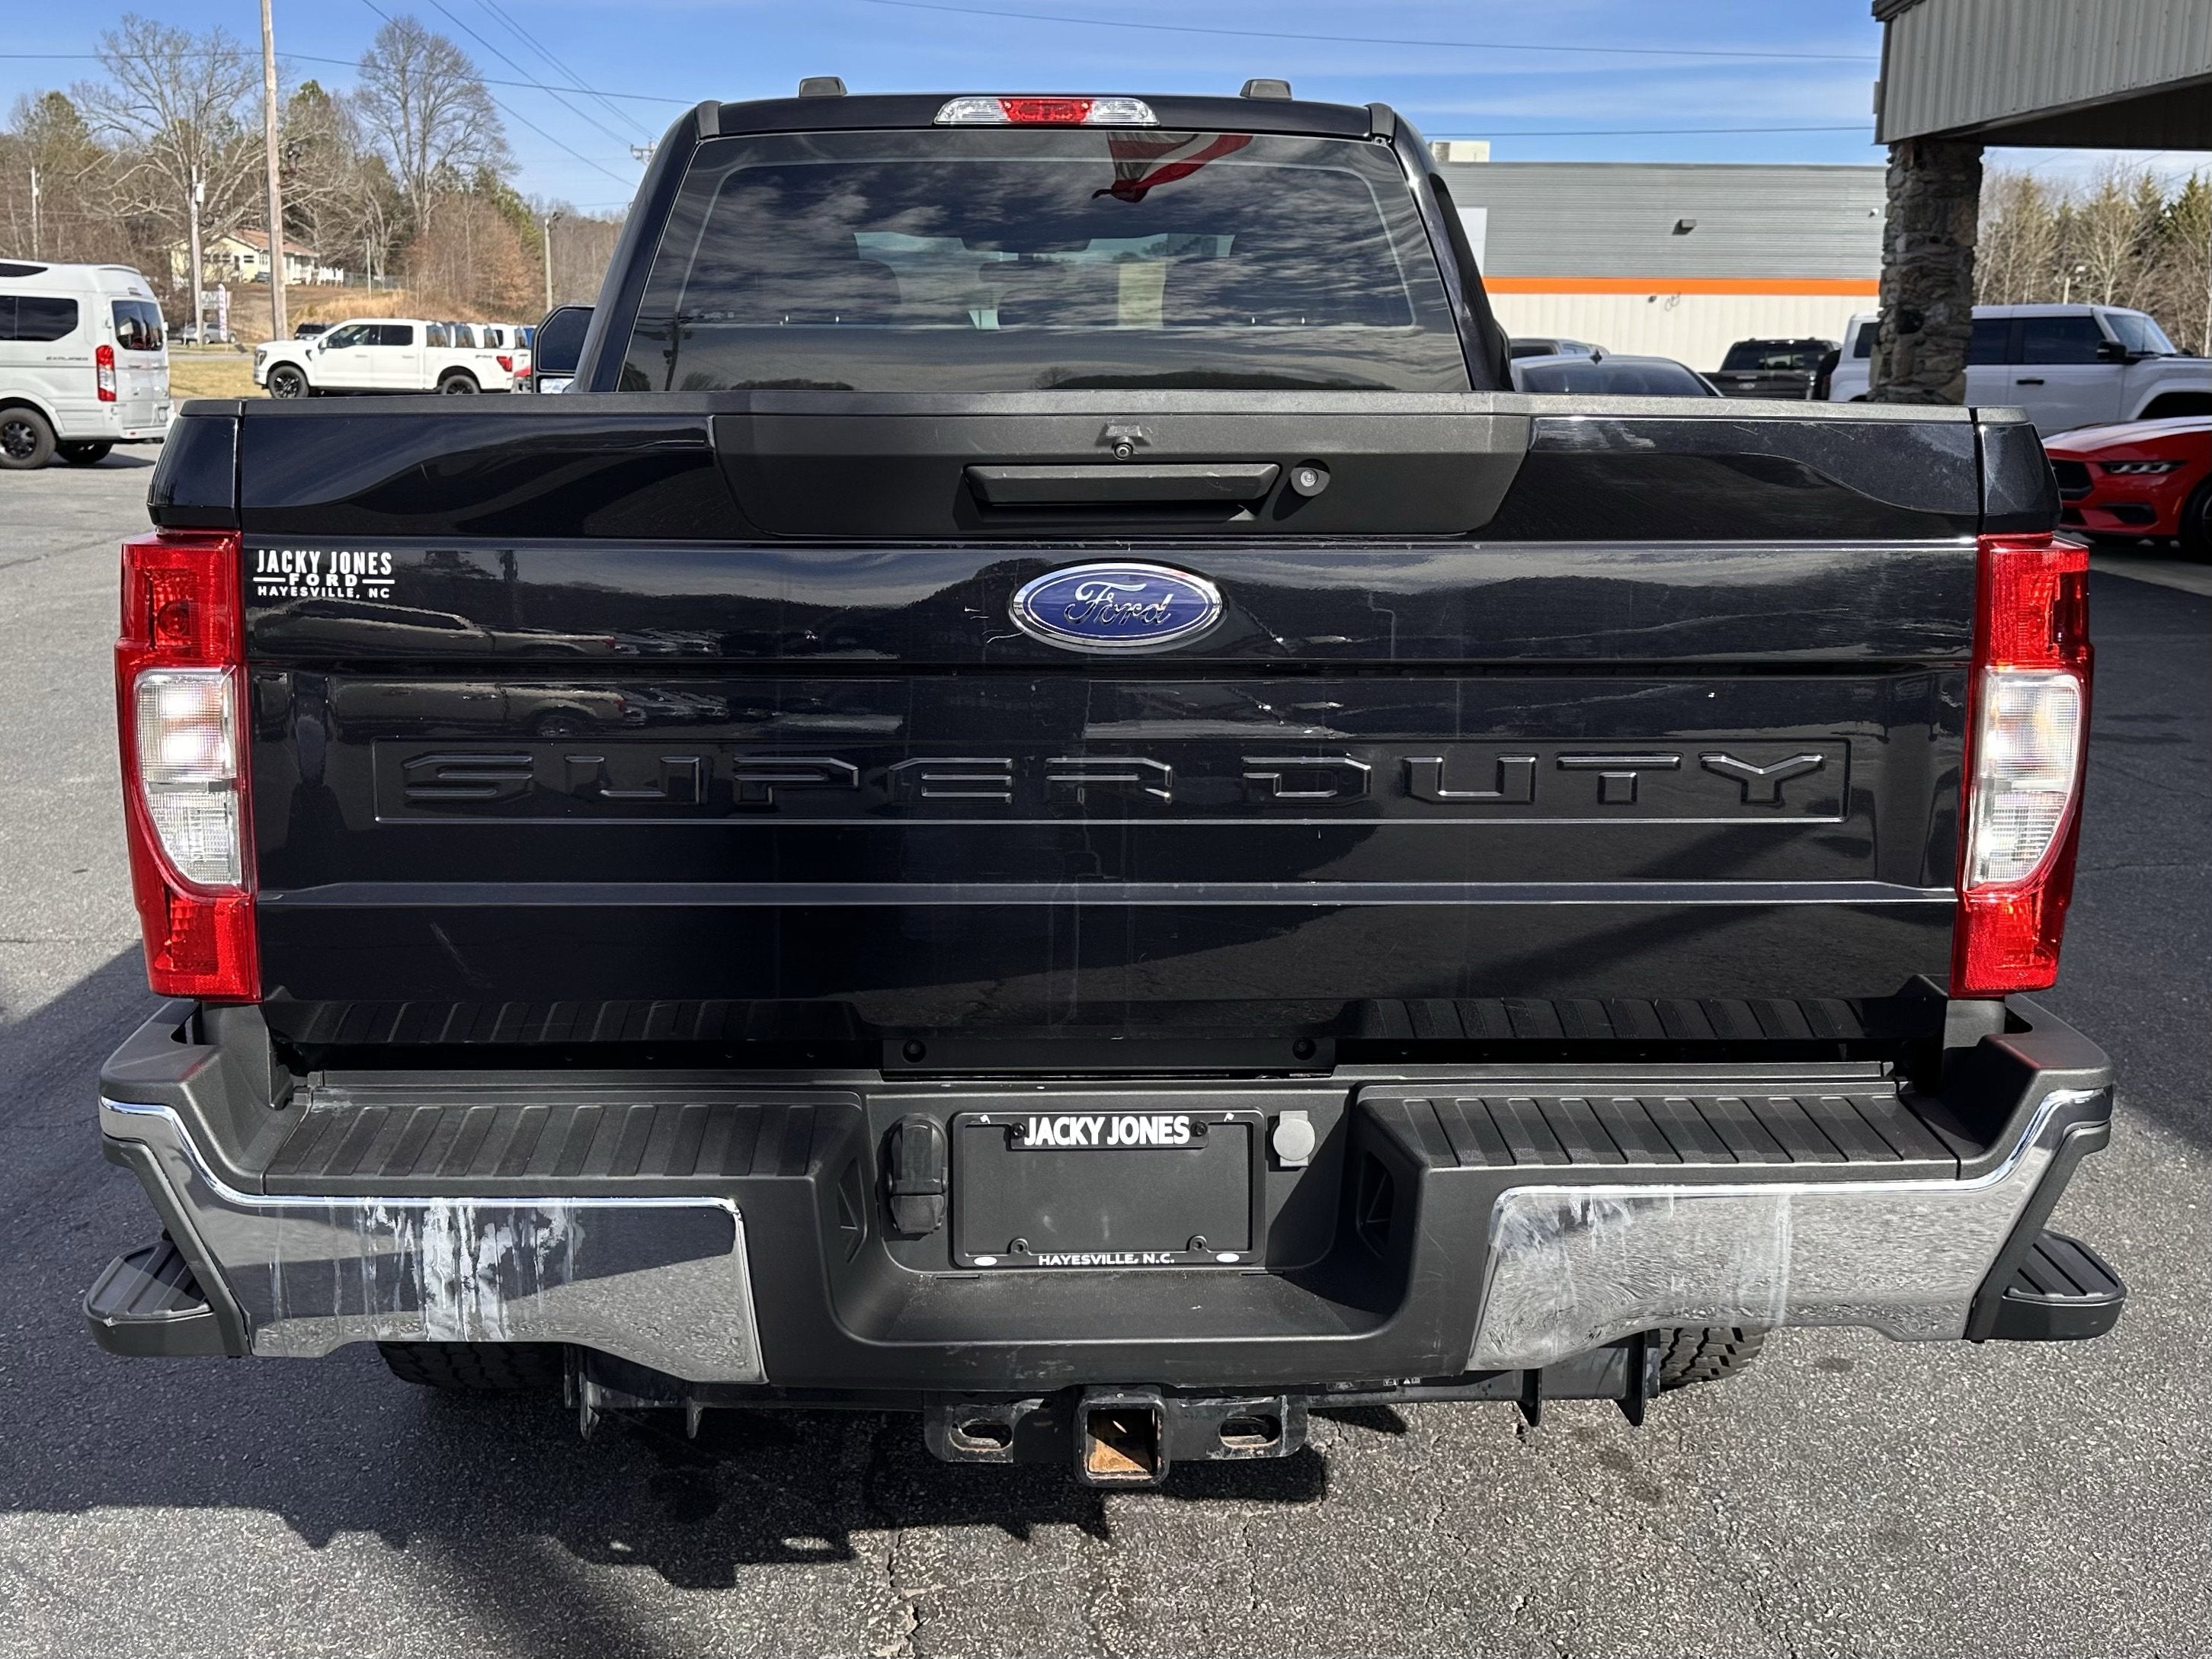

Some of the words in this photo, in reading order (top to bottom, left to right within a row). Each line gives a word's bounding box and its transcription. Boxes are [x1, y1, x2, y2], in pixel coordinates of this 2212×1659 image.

[257, 549, 321, 573] JACKY
[330, 551, 392, 575] JONES
[258, 586, 360, 599] HAYESVILLE,
[368, 588, 390, 599] NC
[289, 573, 357, 587] FORD
[1064, 581, 1173, 626] Ford
[403, 754, 1173, 806] SUPER
[1241, 751, 1826, 805] DUTY
[1024, 1116, 1106, 1146] JACKY
[1106, 1115, 1190, 1145] JONES
[1039, 1254, 1139, 1266] HAYESVILLE,
[1142, 1253, 1175, 1265] N.C.
